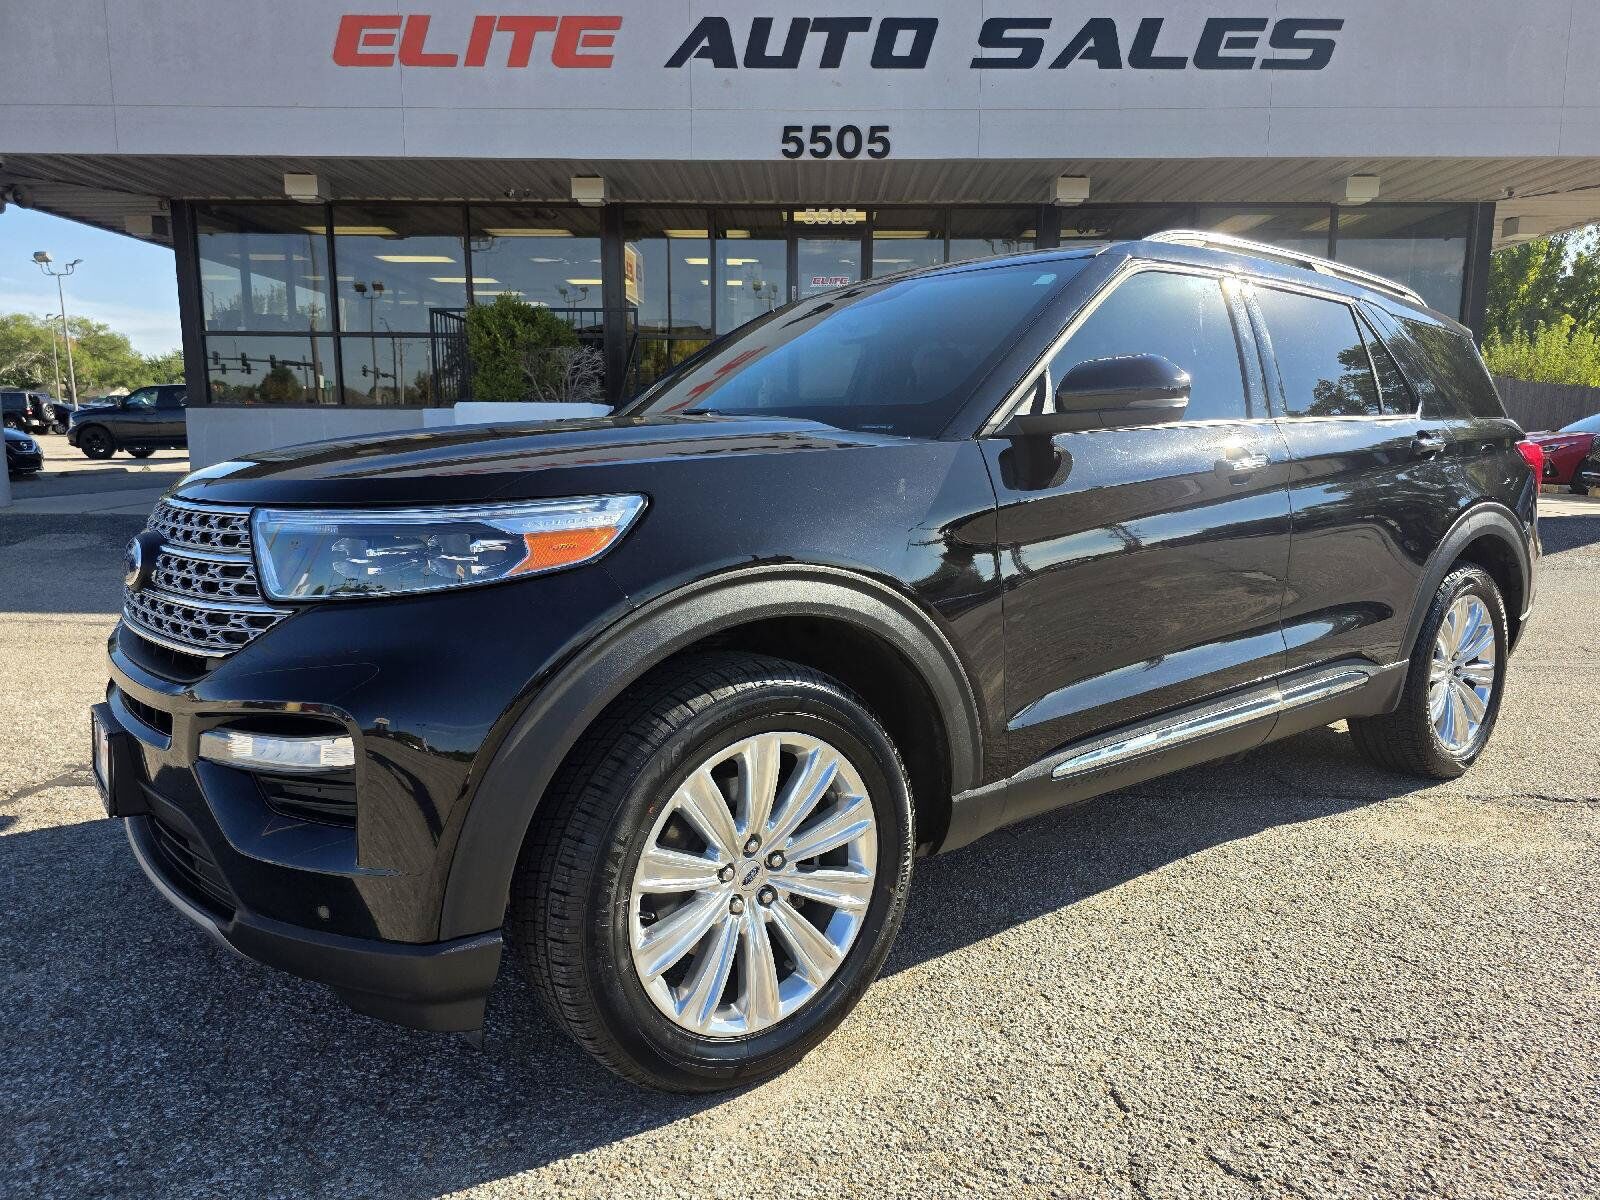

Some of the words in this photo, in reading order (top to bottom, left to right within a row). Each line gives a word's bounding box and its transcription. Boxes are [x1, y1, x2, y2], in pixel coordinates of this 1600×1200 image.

[332, 15, 622, 68] ELITE
[664, 16, 939, 70] AUTO
[969, 17, 1345, 71] SALES
[781, 125, 892, 160] 5505
[811, 276, 849, 285] ELITE
